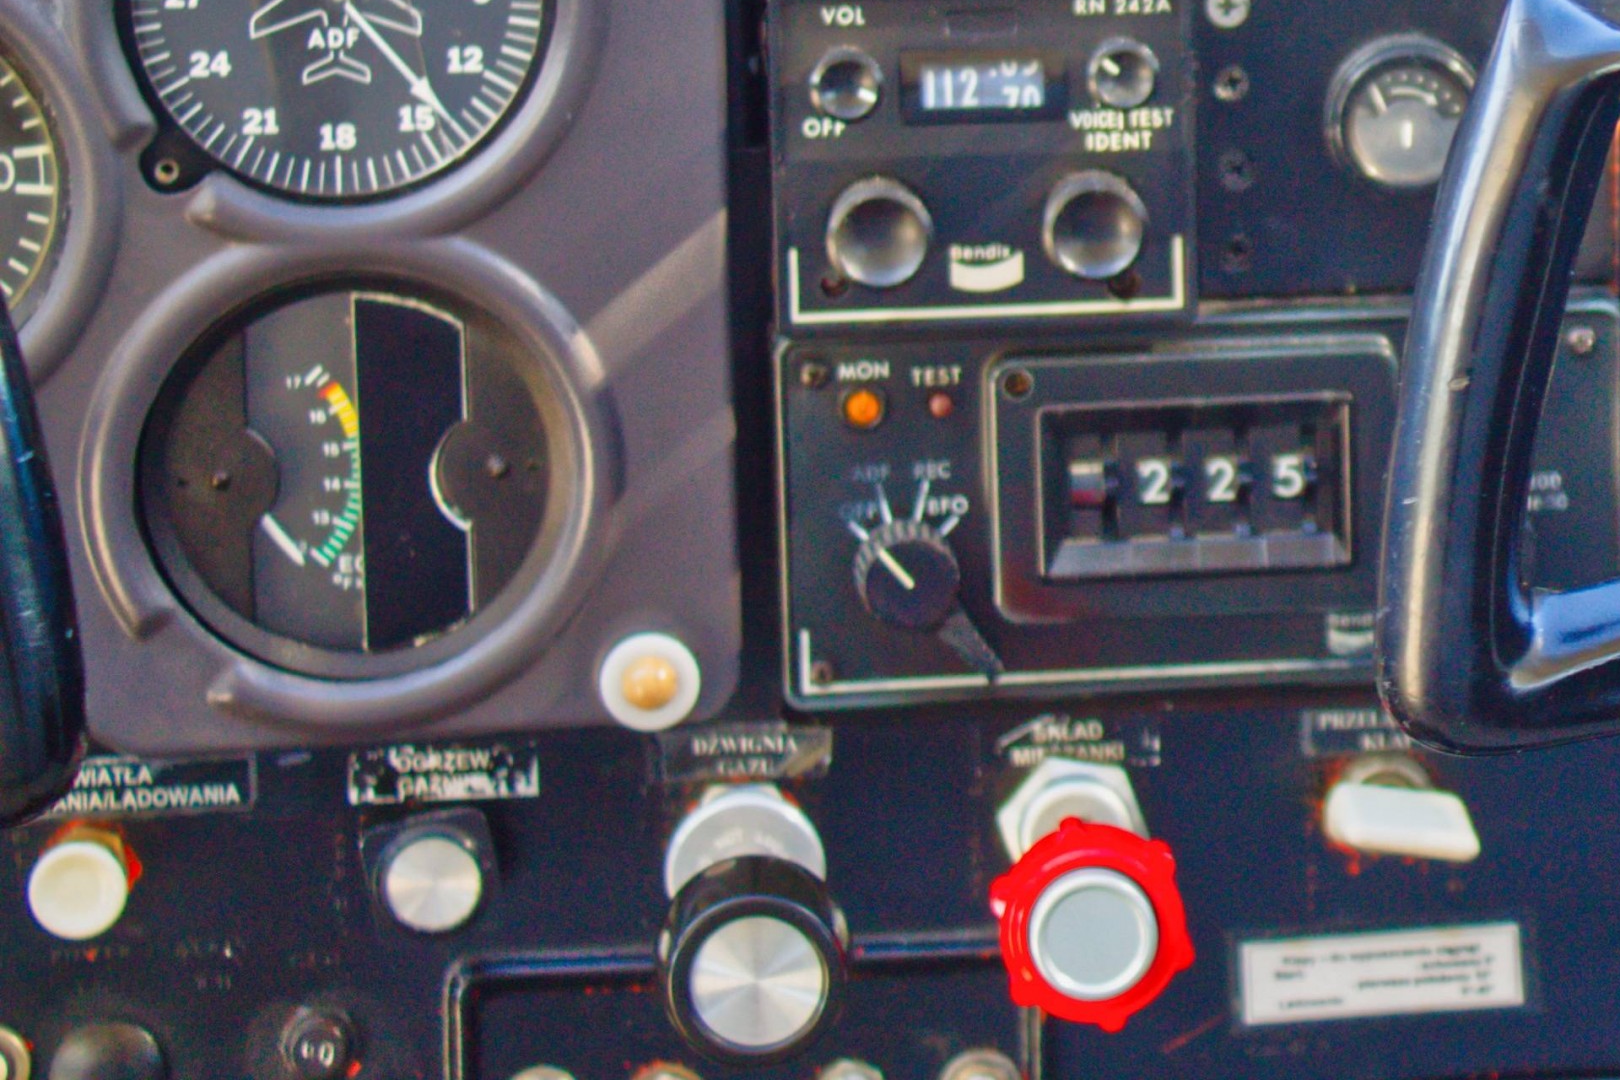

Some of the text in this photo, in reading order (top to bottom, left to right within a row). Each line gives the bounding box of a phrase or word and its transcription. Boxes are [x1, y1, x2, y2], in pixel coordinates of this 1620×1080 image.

[820, 5, 866, 26] VOL
[308, 27, 360, 50] ADF
[189, 51, 230, 77] 24
[447, 47, 484, 73] 12
[921, 69, 980, 109] 112
[243, 108, 279, 135] 21
[399, 106, 434, 133] 15
[802, 119, 847, 139] OFF
[320, 124, 356, 151] 18
[1084, 131, 1153, 152] IDENT
[837, 360, 890, 381] MON
[910, 365, 962, 387] TEST
[1135, 453, 1305, 505] 2 2 5
[927, 494, 969, 516] BFO
[74, 765, 152, 788] WIATŁA
